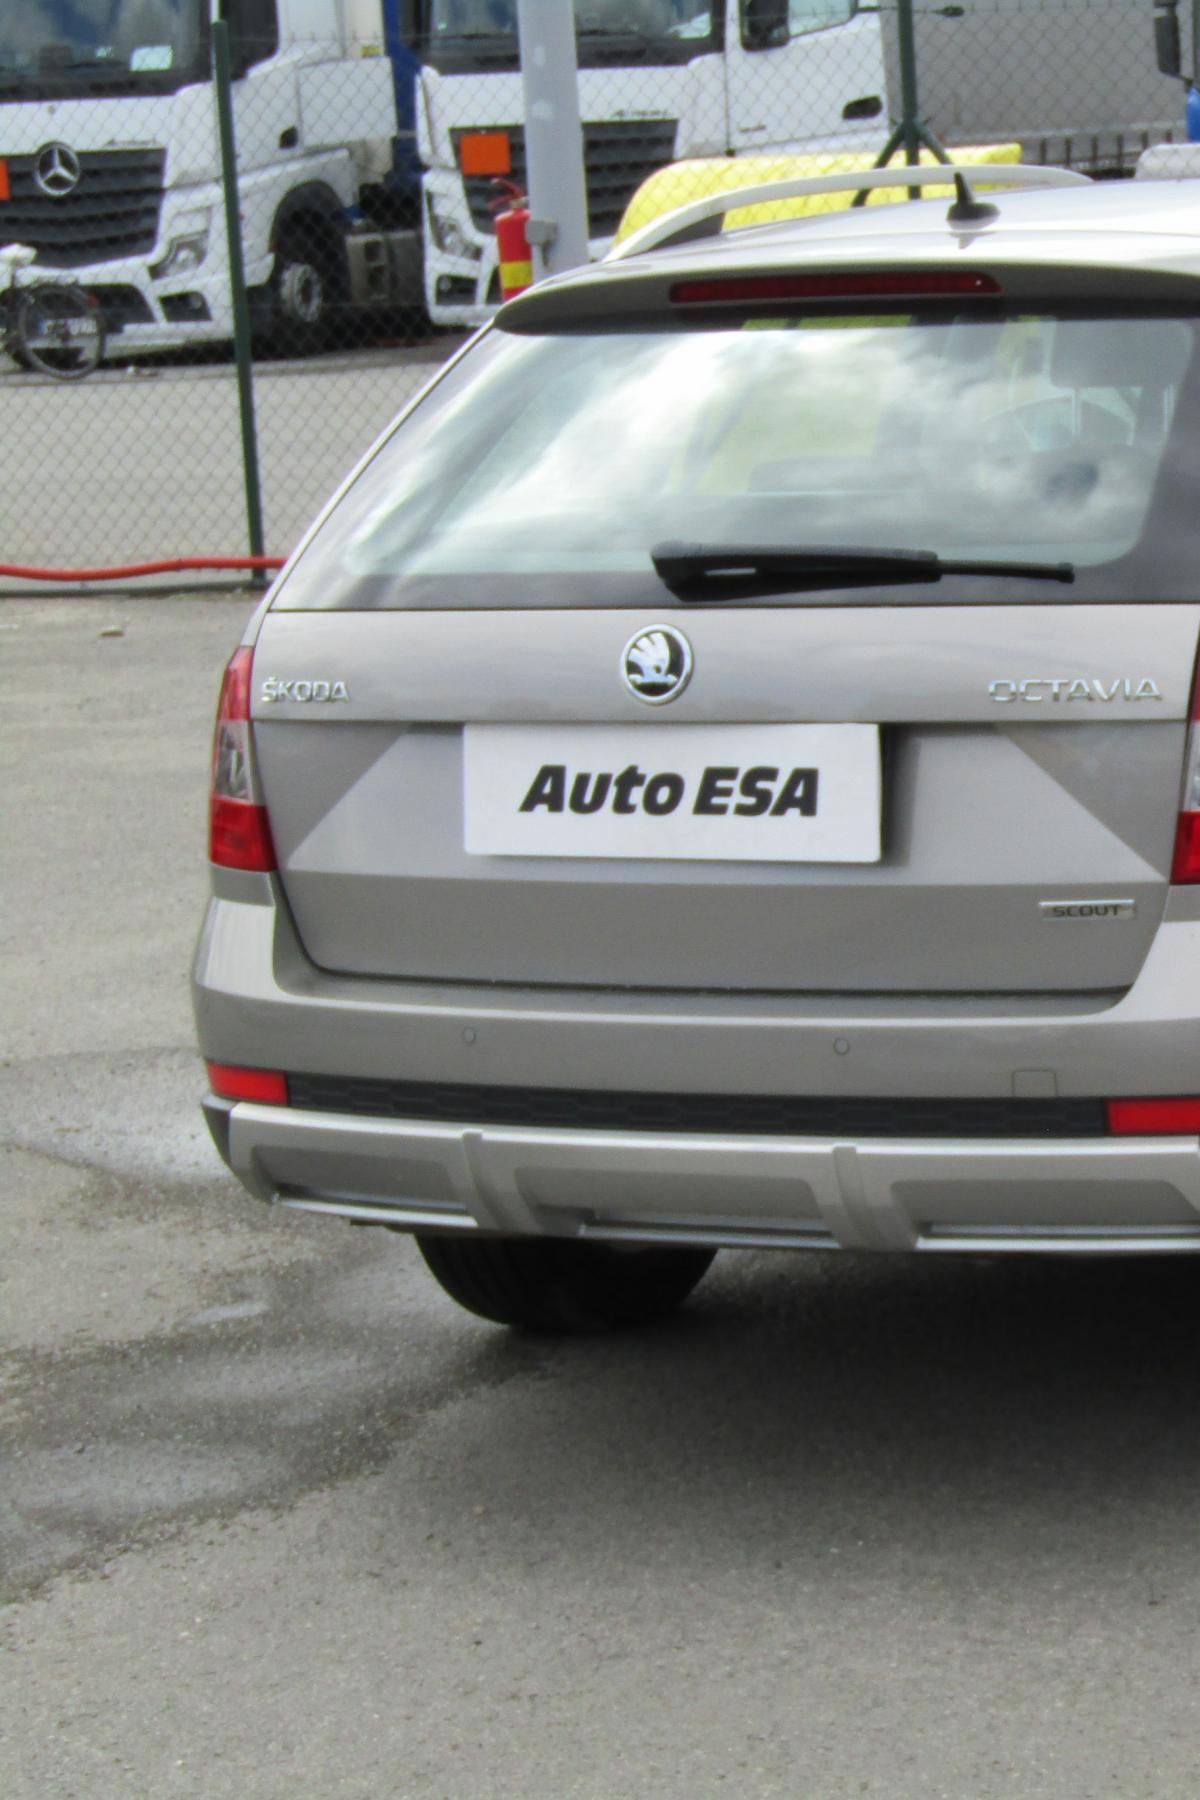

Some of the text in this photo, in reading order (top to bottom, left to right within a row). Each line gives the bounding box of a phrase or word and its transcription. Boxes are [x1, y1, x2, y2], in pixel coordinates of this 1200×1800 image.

[261, 676, 349, 702] ŠKODA
[988, 678, 1163, 702] OCTAVIA
[518, 764, 819, 817] Auto ESA
[1053, 905, 1120, 917] SCOUT
